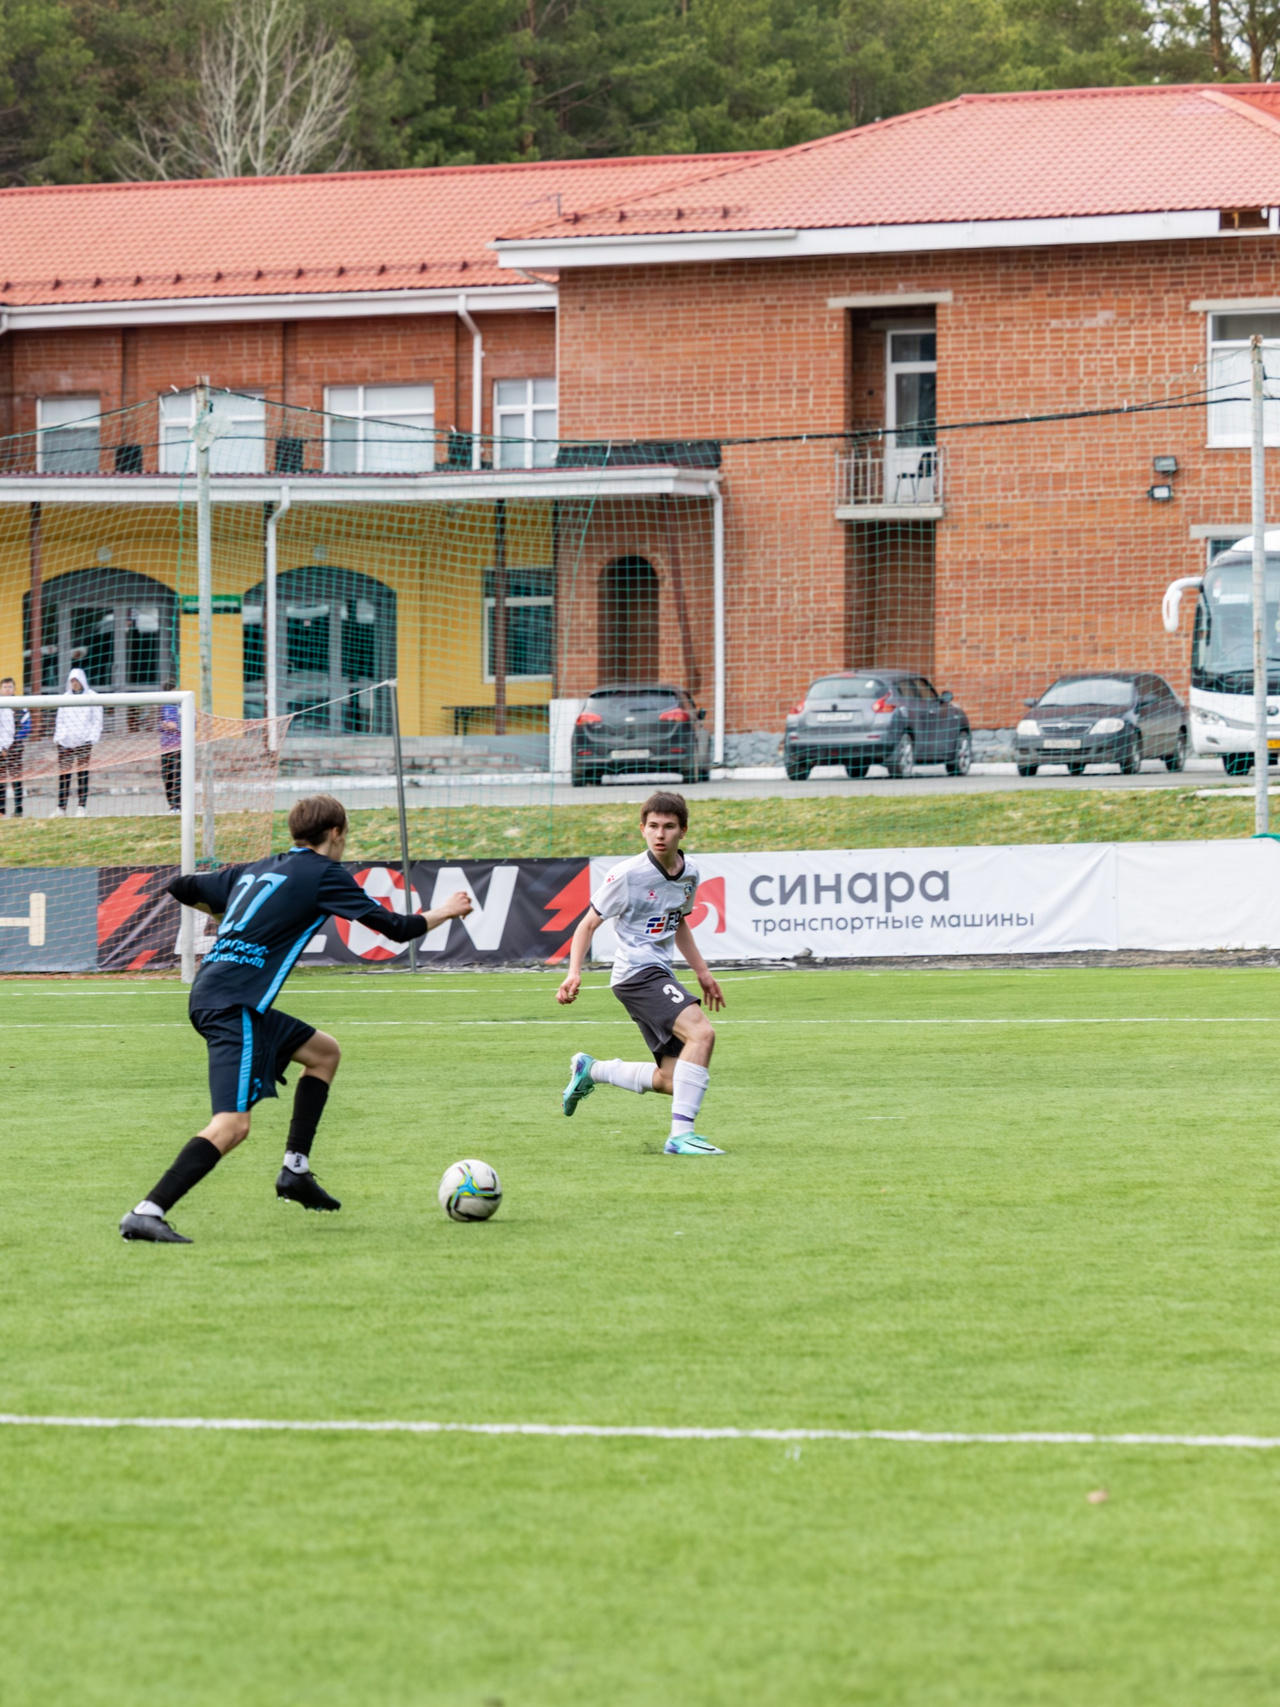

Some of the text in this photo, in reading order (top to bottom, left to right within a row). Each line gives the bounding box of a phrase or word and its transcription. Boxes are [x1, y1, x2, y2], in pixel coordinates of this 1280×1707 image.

[217, 872, 288, 936] 27
[749, 869, 950, 913] синара
[752, 912, 1034, 937] транспортные машины
[662, 983, 685, 1004] 3
